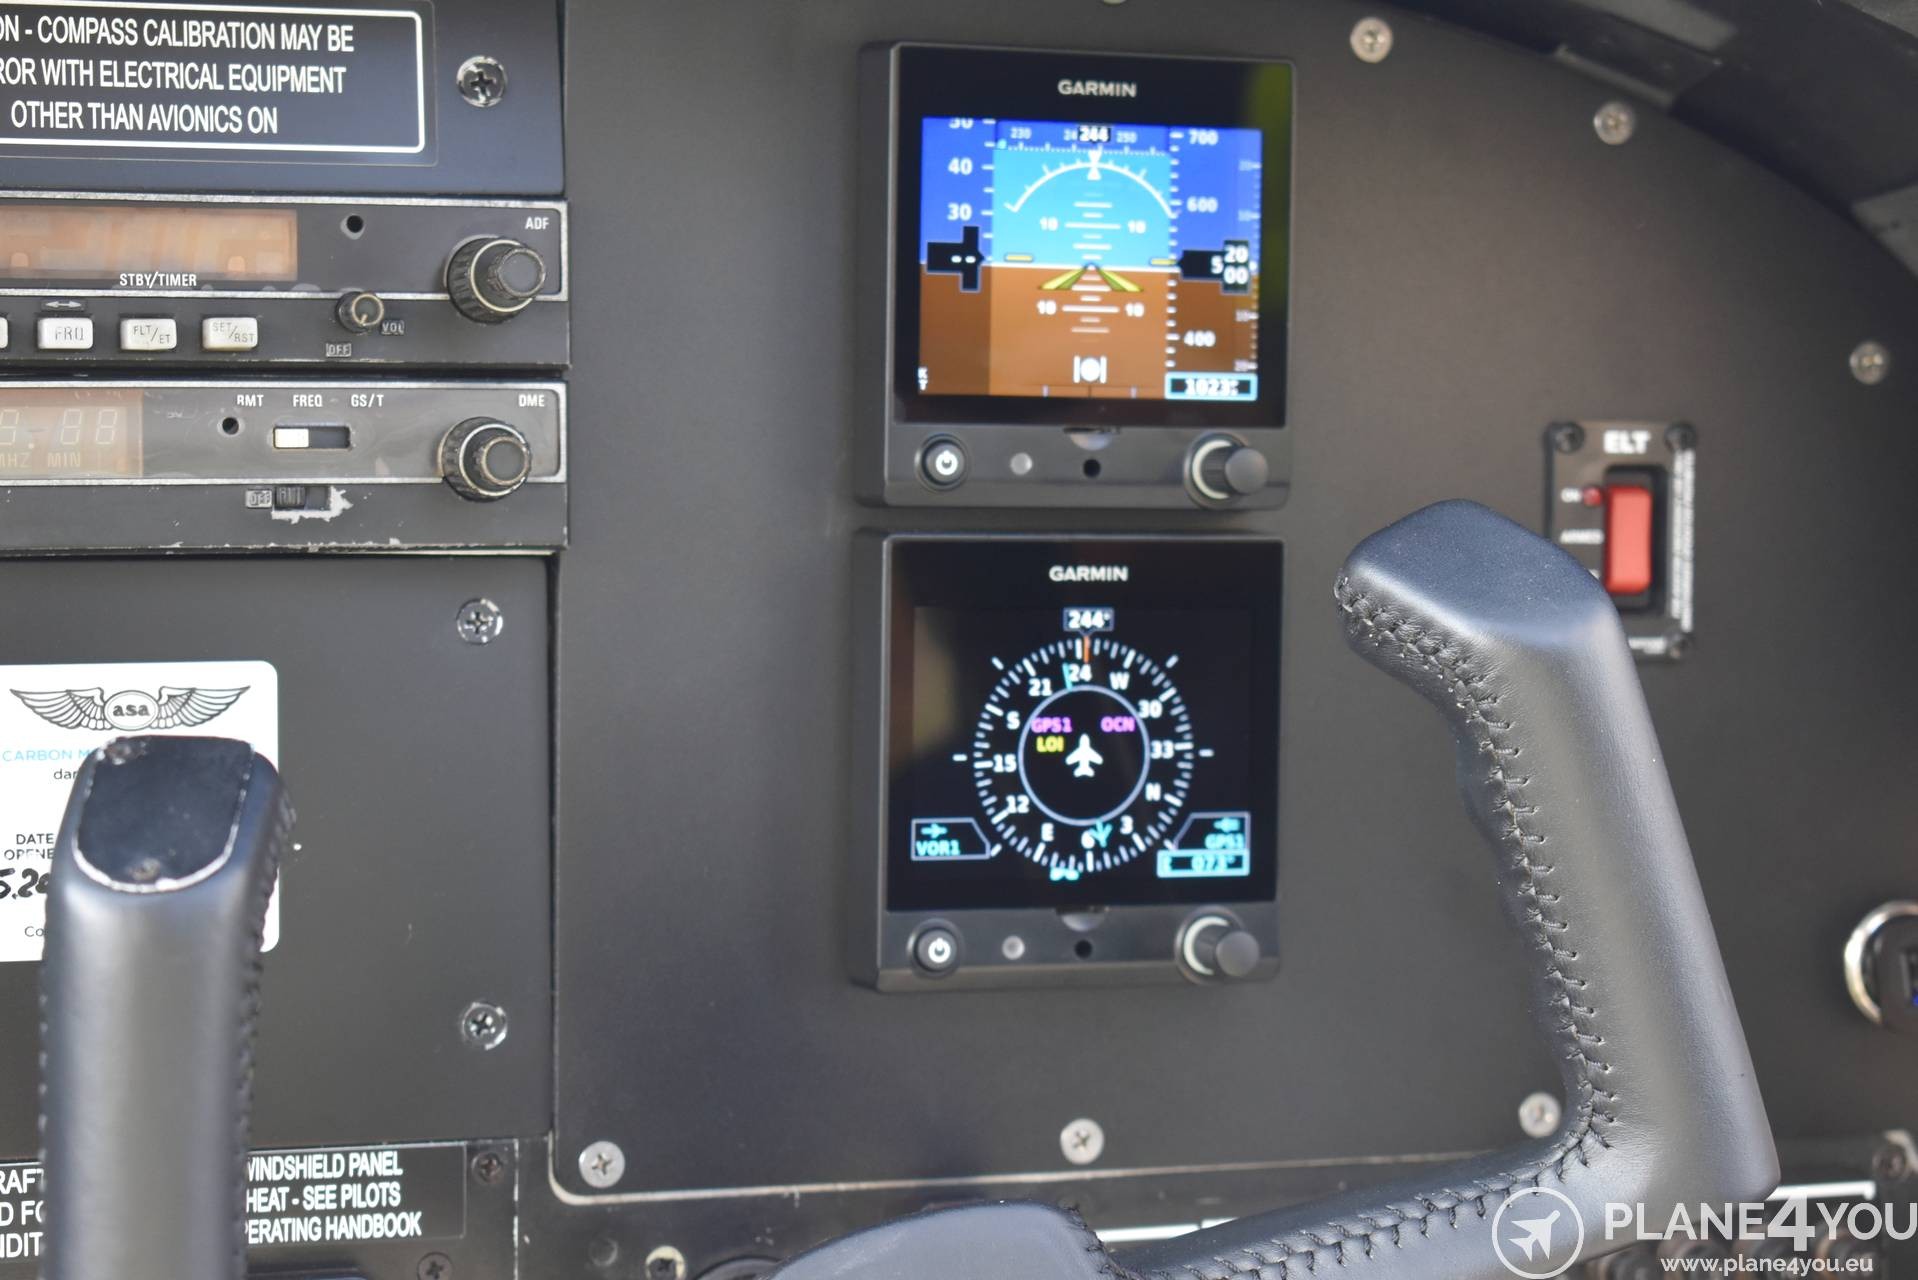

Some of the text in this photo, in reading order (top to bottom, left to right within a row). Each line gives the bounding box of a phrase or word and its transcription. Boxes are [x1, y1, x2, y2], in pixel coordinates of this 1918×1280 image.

[37, 15, 138, 46] COMPASS
[143, 19, 275, 50] CALIBRATION
[281, 23, 322, 51] MAY
[327, 25, 354, 52] BE
[41, 57, 94, 87] WITH
[100, 60, 224, 90] ELECTRICAL
[229, 64, 347, 94] EQUIPMENT
[1058, 80, 1137, 98] GARMIN
[11, 100, 278, 134] OTHER THAN AVIONICS ON
[1079, 125, 1109, 143] 244
[1188, 129, 1219, 146] 700
[948, 158, 973, 175] 40
[947, 204, 973, 221] 30
[1186, 198, 1218, 213] 600
[525, 216, 550, 230] ADF
[1039, 217, 1058, 231] 10
[1127, 219, 1147, 234] 10
[119, 271, 197, 289] STBY/TIMER
[1036, 300, 1057, 315] 10
[1125, 302, 1145, 317] 10
[1184, 331, 1216, 346] 400
[327, 343, 351, 357] OFF
[236, 394, 264, 407] RMT
[292, 394, 323, 407] FREQ
[351, 394, 384, 407] GS/T
[518, 394, 545, 407] DME
[1604, 429, 1650, 454] ELT
[1049, 565, 1129, 582] GARMIN
[1069, 664, 1093, 682] 24
[1109, 672, 1131, 690] W
[1028, 679, 1053, 697] 21
[112, 703, 150, 717] asa
[1137, 700, 1164, 719] 30
[1006, 711, 1021, 730] S
[1030, 716, 1136, 734] GPS1 OCN
[2, 749, 73, 762] CARBON
[1151, 740, 1175, 759] 33
[993, 754, 1018, 773] 15
[1146, 783, 1162, 801] N
[1005, 795, 1030, 814] 12
[1041, 823, 1054, 842] E
[1120, 815, 1134, 834] 3
[16, 833, 54, 845] DATE
[1080, 831, 1096, 849] 6
[348, 1151, 403, 1178] PANEL
[246, 1186, 290, 1213] HEAT
[302, 1184, 338, 1211] SEE
[341, 1181, 401, 1209] PILOTS
[245, 1211, 422, 1244] ERATING HANDBOOK
